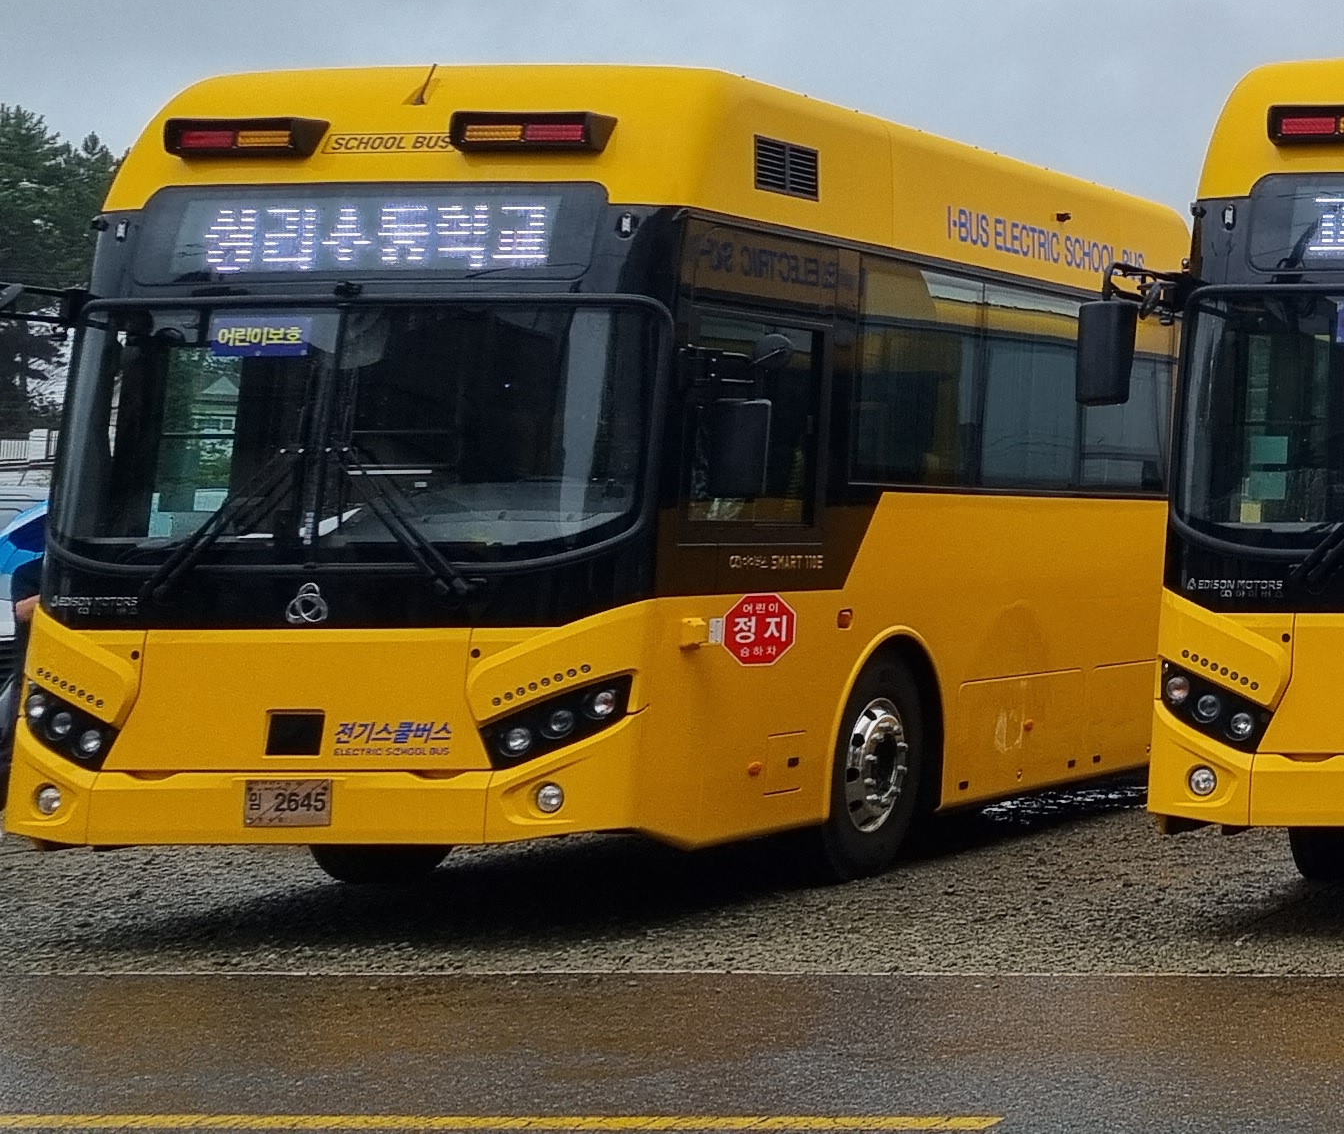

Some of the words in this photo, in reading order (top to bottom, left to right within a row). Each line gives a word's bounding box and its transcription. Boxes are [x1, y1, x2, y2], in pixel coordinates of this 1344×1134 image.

[331, 136, 406, 150] SCHOOL
[411, 135, 452, 149] BUS
[947, 205, 989, 248] I-BUS
[994, 217, 1060, 264] ELECTRIC
[1064, 235, 1121, 276] SCHOOL
[217, 326, 303, 346] 어린이보호
[1198, 579, 1235, 590] EDISON
[1237, 579, 1284, 590] MOTORS
[742, 603, 779, 614] 어린이
[733, 615, 787, 643] 정지
[334, 721, 452, 744] 전기스쿨버스
[334, 747, 382, 756] ELECTRIC
[385, 747, 427, 756] SCHOOL
[429, 747, 450, 756] BUS
[249, 792, 262, 811] 임
[274, 792, 326, 812] 2645
